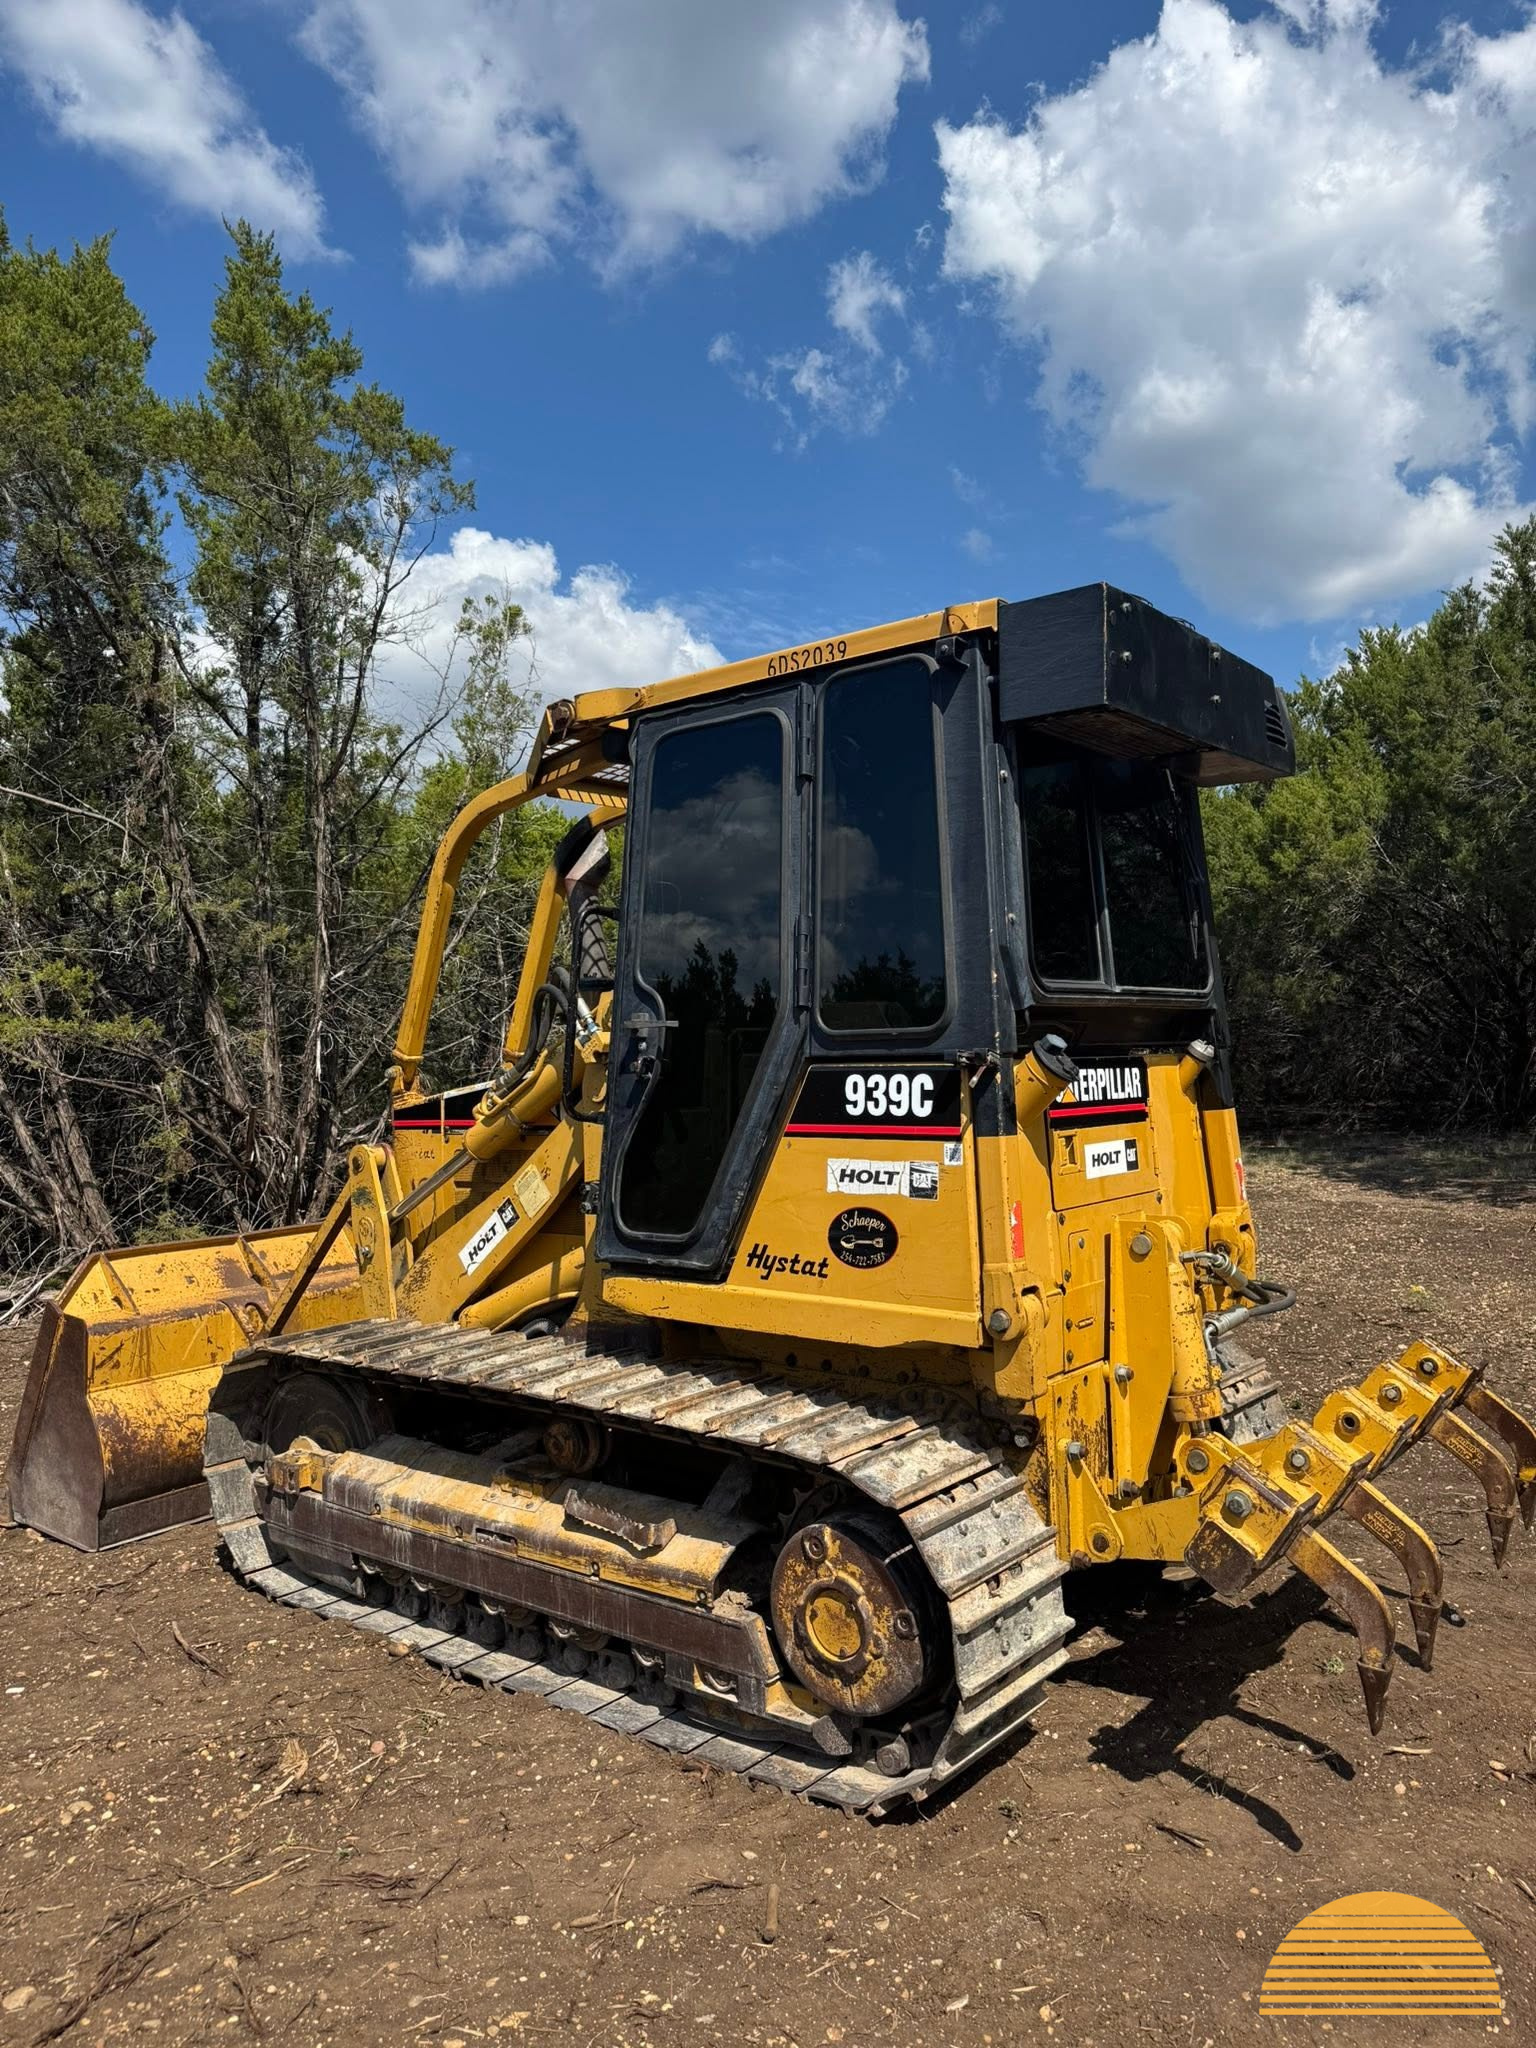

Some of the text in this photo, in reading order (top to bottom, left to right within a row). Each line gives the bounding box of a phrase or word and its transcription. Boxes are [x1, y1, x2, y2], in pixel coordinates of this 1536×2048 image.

[767, 640, 847, 677] 6DS2039
[845, 1073, 934, 1118] 939C
[838, 1168, 900, 1186] HOLT
[1092, 1150, 1121, 1167] HOLT
[841, 1210, 886, 1231] Schaeper
[468, 1222, 497, 1262] HOLT
[746, 1243, 829, 1280] Hystat
